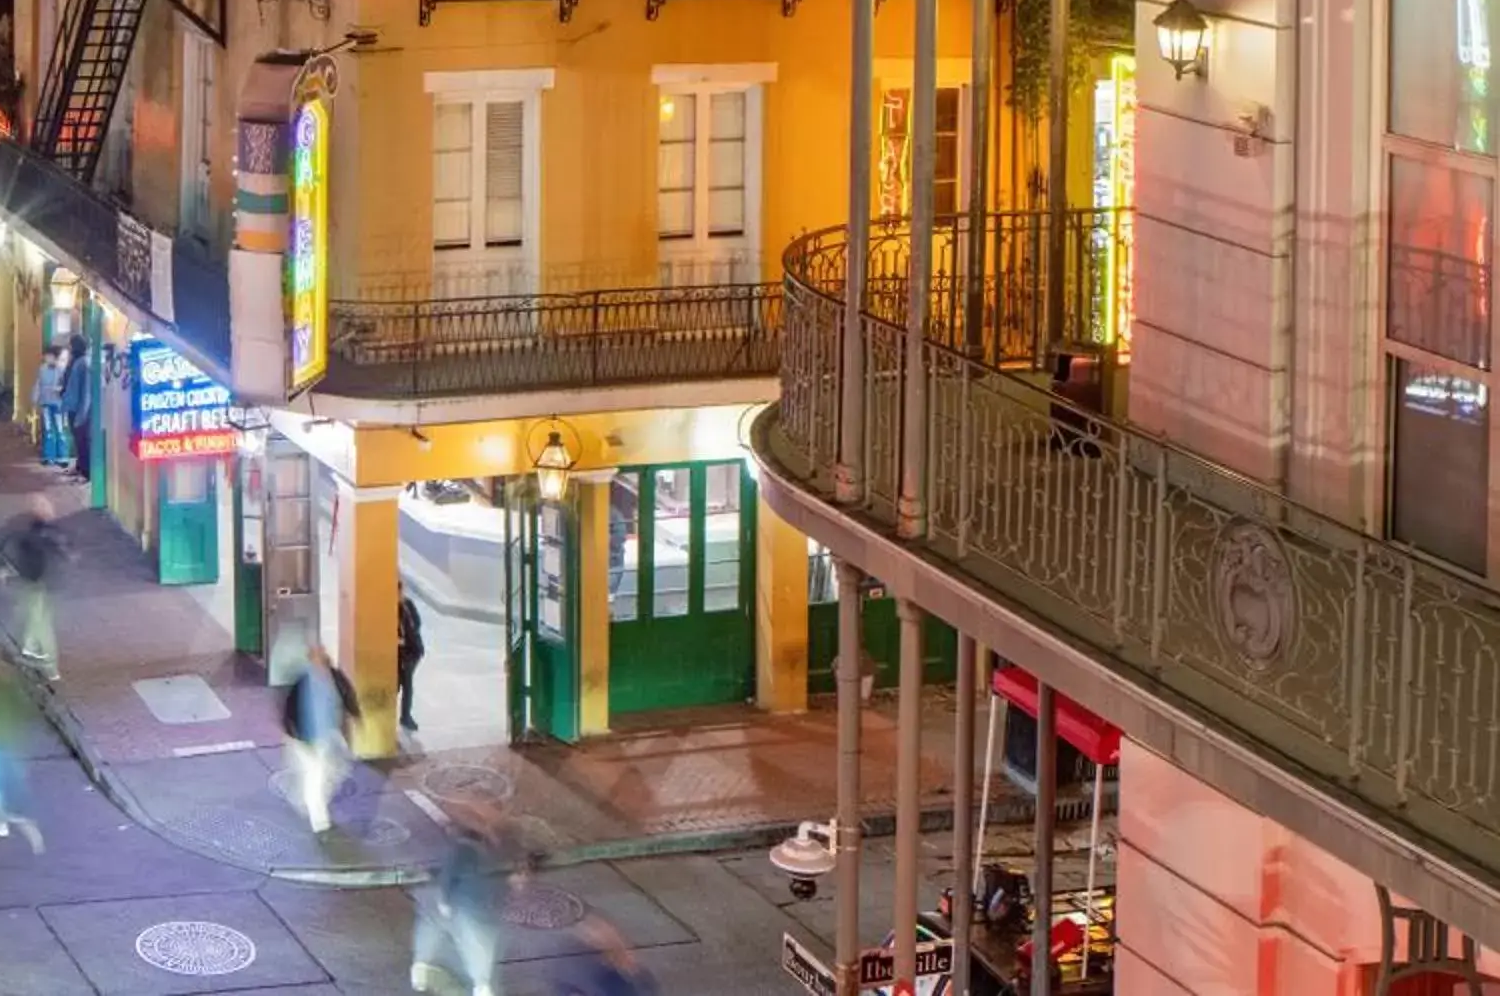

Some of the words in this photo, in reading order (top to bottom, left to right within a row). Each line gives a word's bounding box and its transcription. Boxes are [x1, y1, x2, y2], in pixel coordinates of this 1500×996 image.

[151, 410, 198, 433] CRAFT
[143, 439, 180, 457] TACOS
[866, 954, 949, 979] Ibeille
